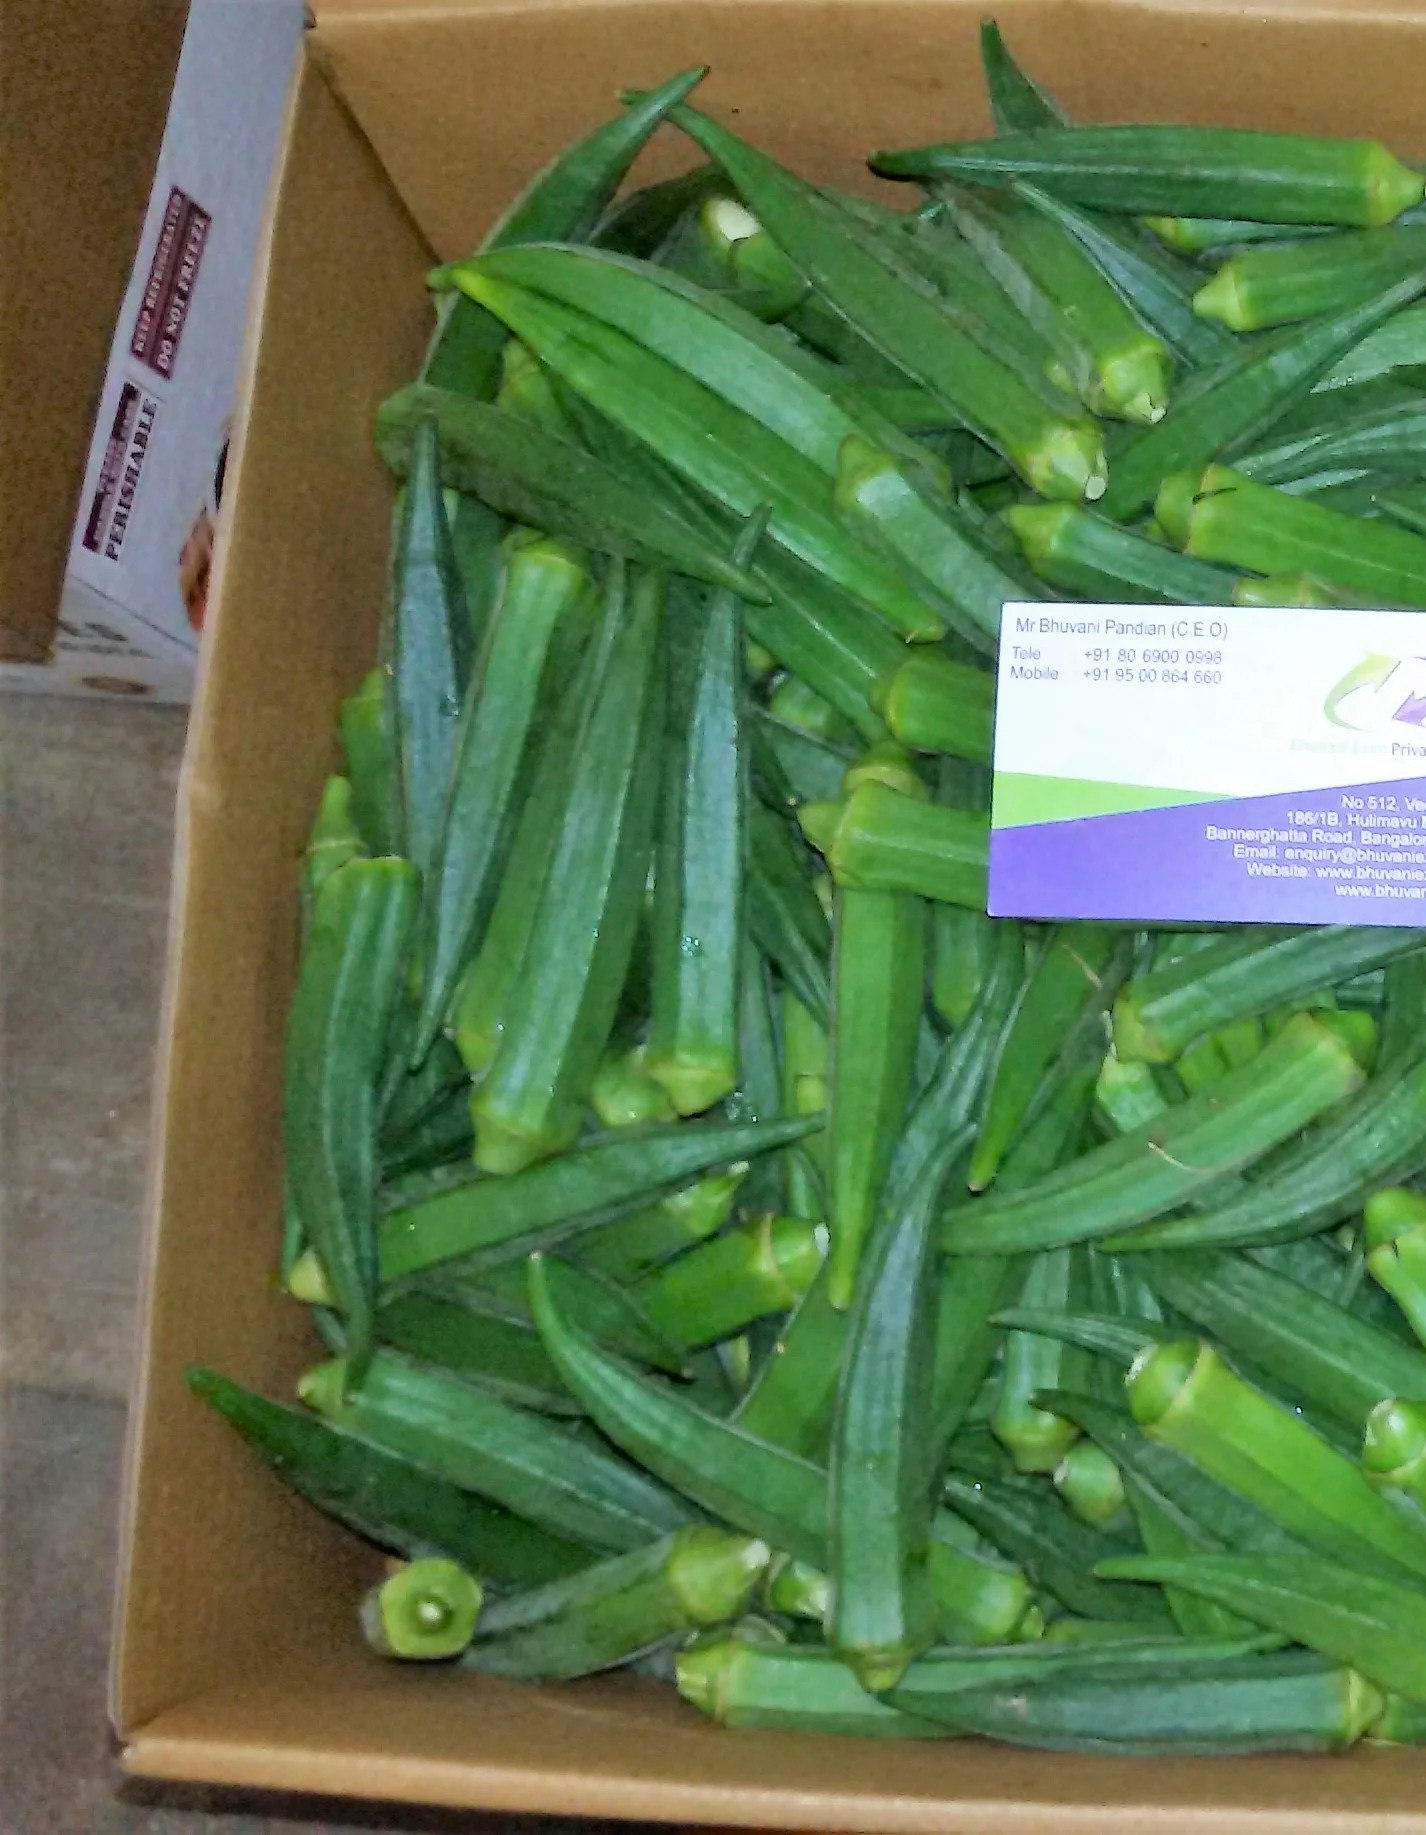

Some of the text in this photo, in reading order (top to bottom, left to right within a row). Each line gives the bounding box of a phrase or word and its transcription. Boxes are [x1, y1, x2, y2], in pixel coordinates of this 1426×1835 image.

[104, 398, 157, 561] PERISHABLE
[1015, 617, 1036, 633] Mr
[1039, 618, 1100, 634] Bhuvani
[1105, 619, 1166, 636] Pandian
[1012, 646, 1222, 665] Tele +91 80 6900 0998
[1010, 666, 1221, 684] Mobile +91 95 00 864 660
[1347, 813, 1418, 830] Hulimavu
[1205, 825, 1308, 845] Bannerghatta
